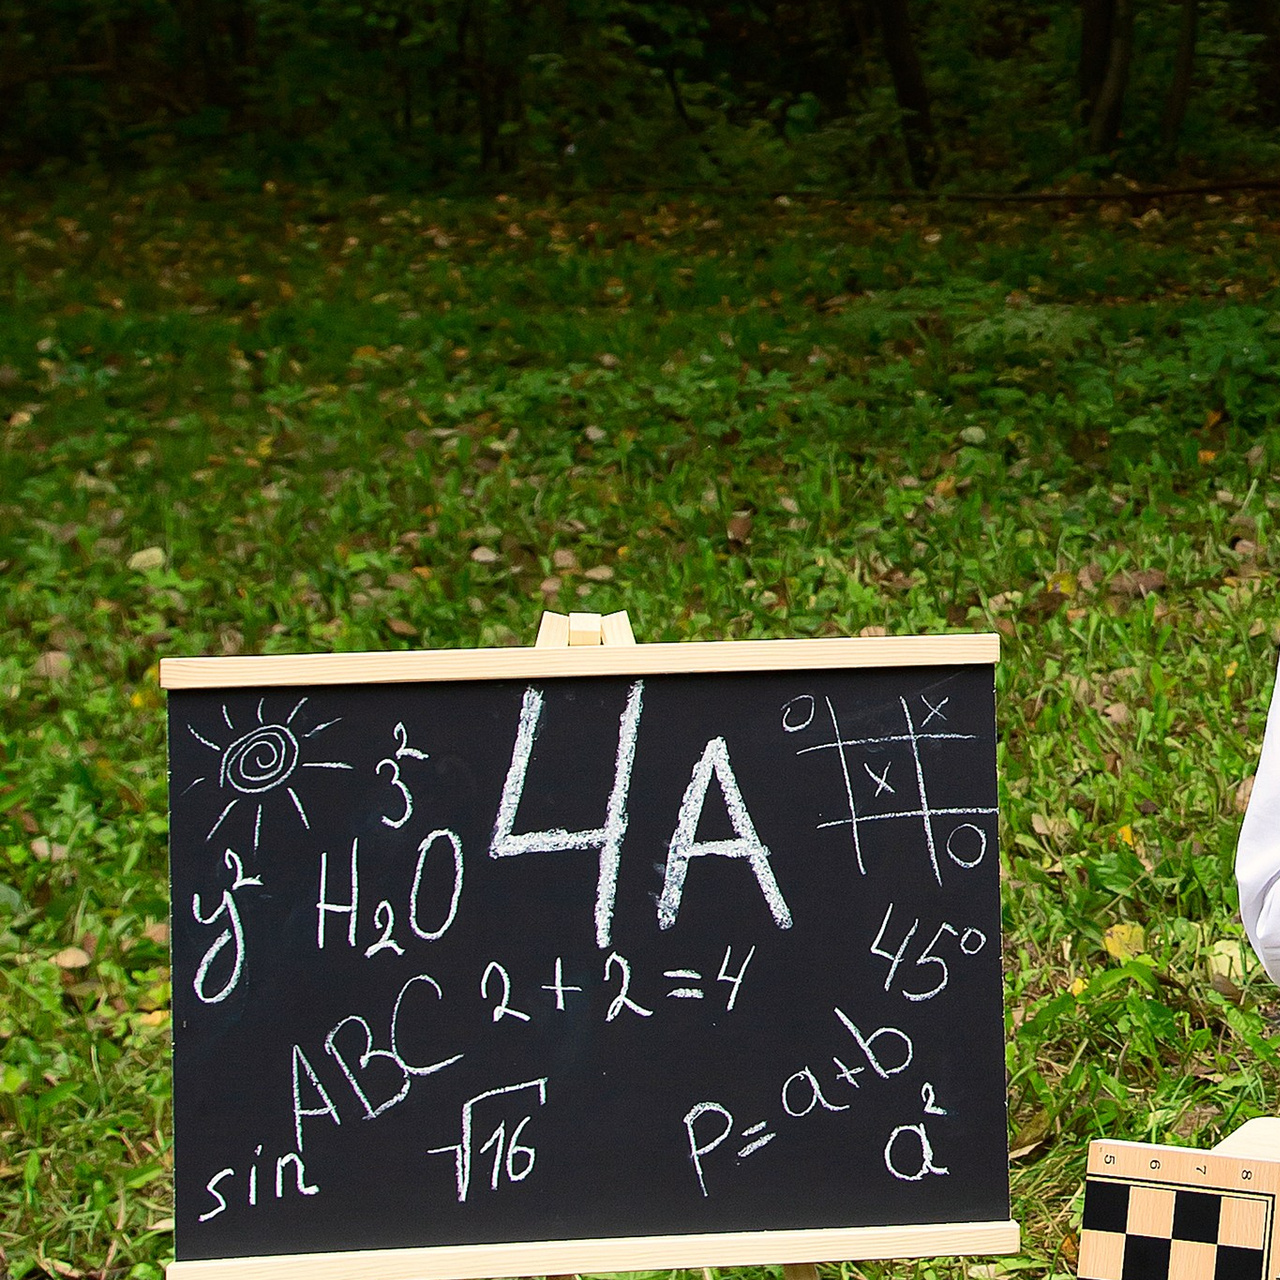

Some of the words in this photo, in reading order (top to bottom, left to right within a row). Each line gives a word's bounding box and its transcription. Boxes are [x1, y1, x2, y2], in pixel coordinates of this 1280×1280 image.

[292, 974, 465, 1152] ABC
[198, 1144, 320, 1222] sin
[1103, 1154, 1116, 1165] 5
[1149, 1159, 1161, 1170] 6
[1195, 1164, 1207, 1175] 7
[1241, 1169, 1253, 1180] 8
